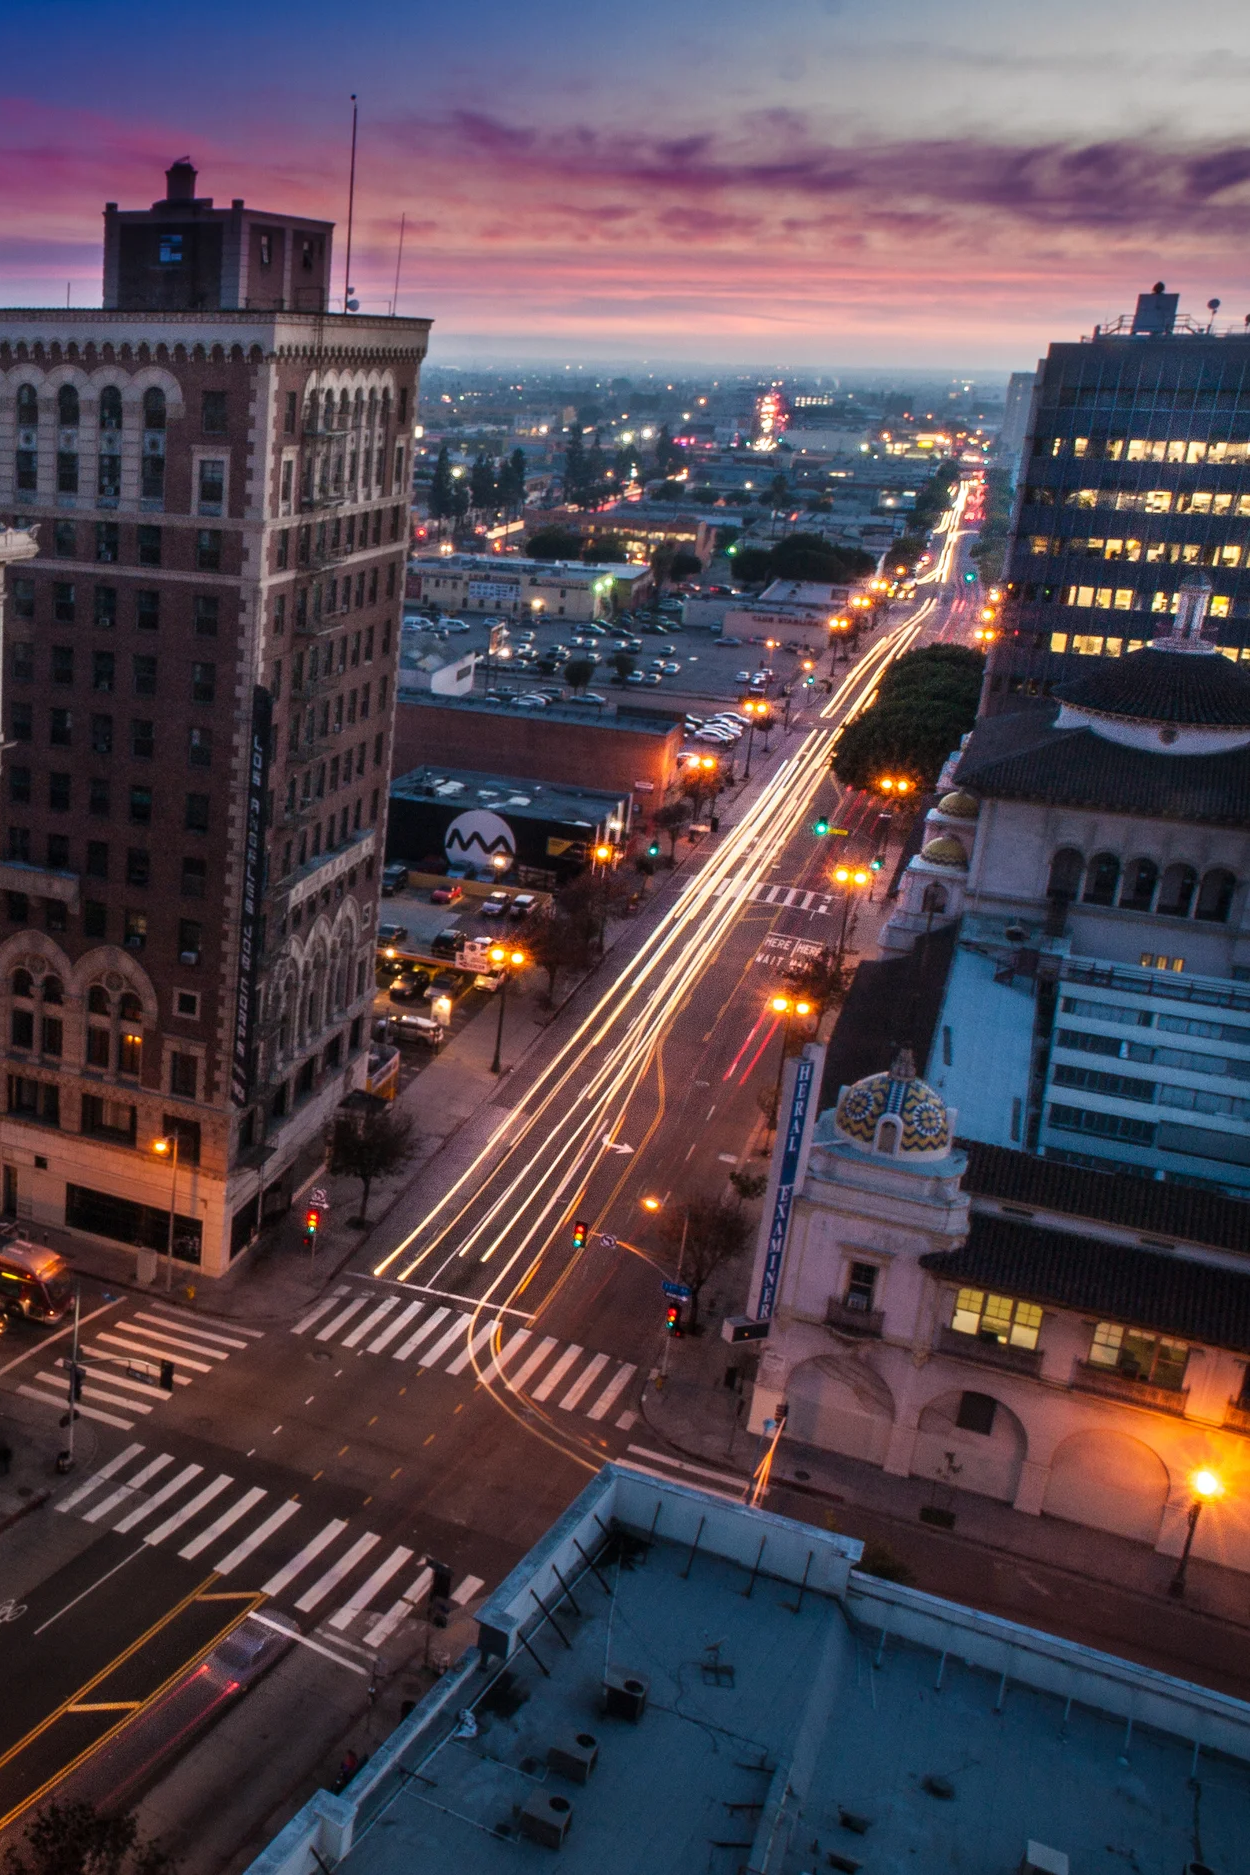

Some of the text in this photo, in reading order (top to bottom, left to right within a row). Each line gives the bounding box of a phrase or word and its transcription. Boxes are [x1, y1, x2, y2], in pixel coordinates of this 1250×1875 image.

[764, 936, 792, 951] HERE
[755, 952, 785, 967] WAIT
[760, 1064, 811, 1318] HERAL EXAMINER
